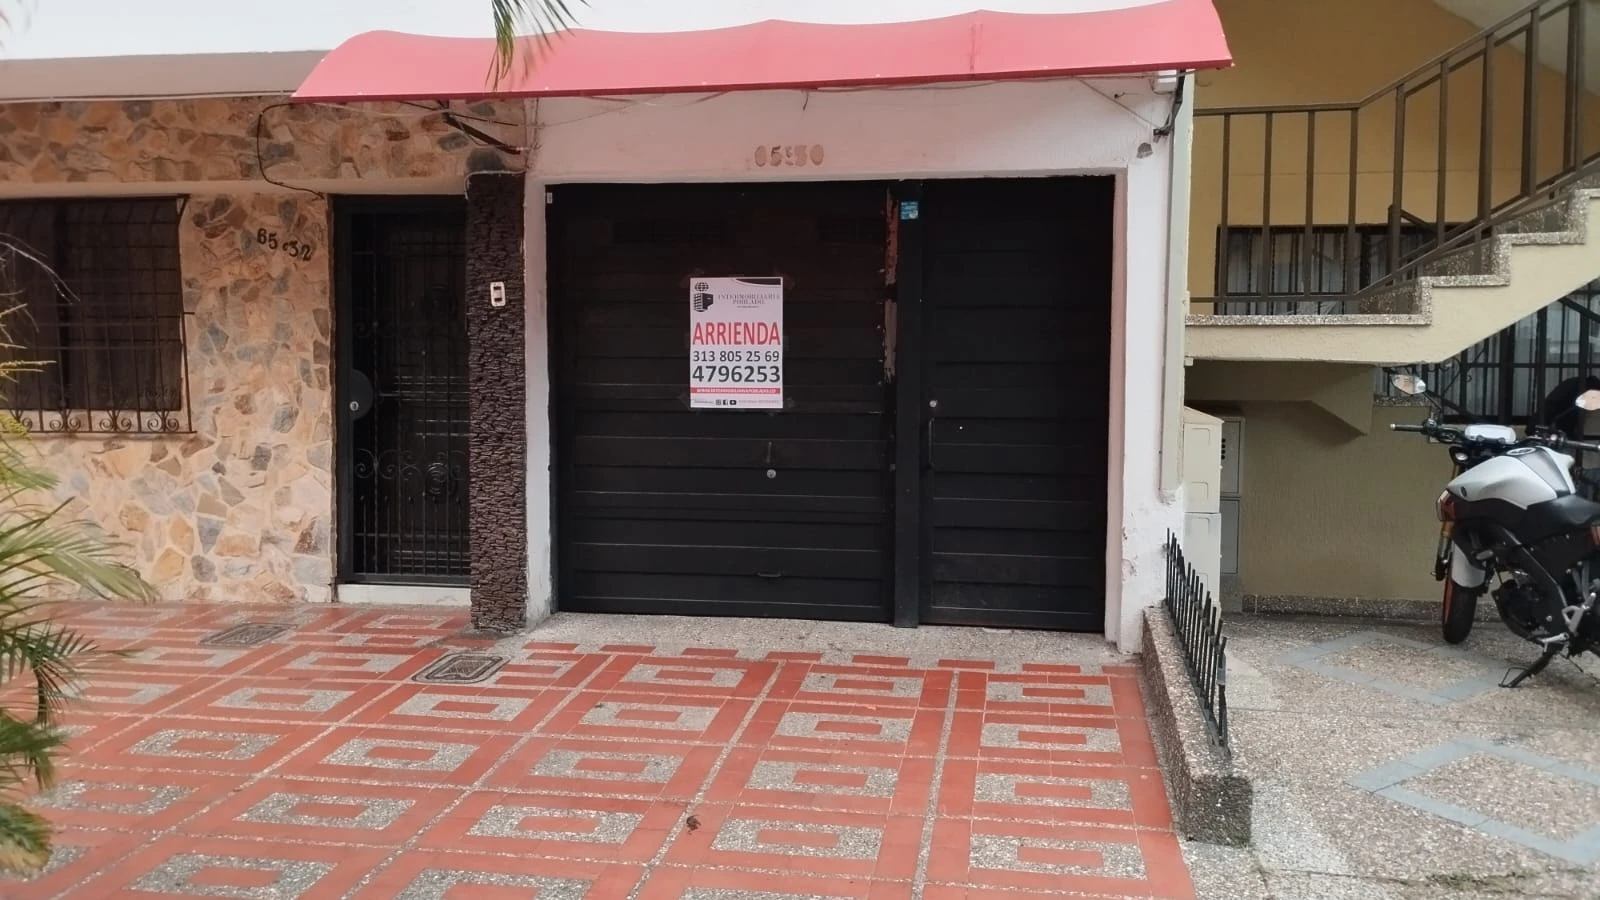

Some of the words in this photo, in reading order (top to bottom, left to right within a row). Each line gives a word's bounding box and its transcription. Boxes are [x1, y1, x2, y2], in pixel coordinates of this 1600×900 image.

[692, 322, 781, 345] ARRIENDA
[693, 351, 716, 362] 313
[719, 351, 742, 362] 805
[746, 351, 761, 362] 25
[764, 351, 780, 362] 69
[692, 365, 781, 383] 4796253
